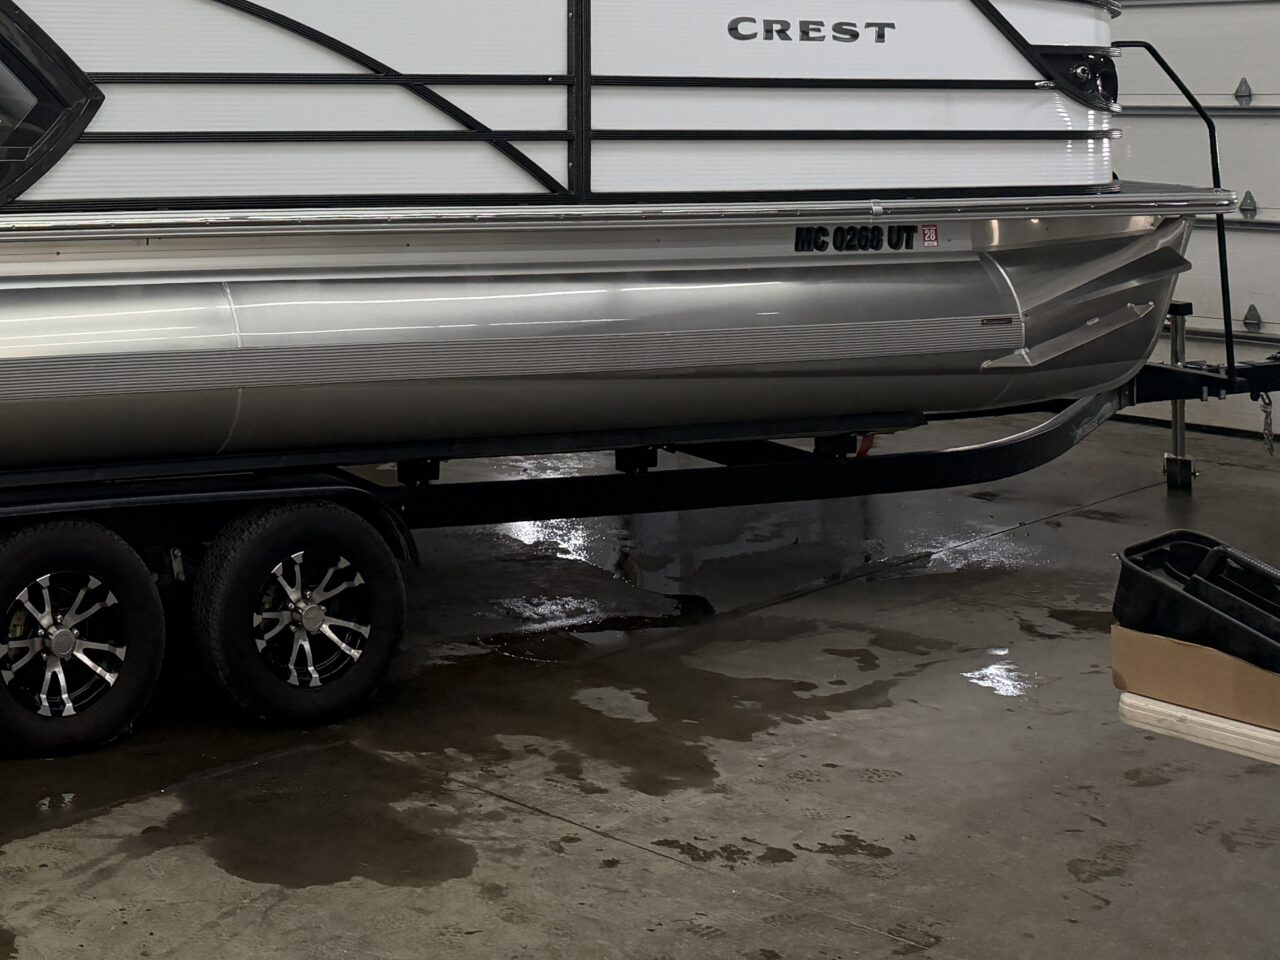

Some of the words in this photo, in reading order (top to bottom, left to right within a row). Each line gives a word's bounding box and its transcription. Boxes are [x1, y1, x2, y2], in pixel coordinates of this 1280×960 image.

[727, 16, 896, 43] CREST
[795, 226, 830, 252] MC
[832, 225, 884, 251] 0268
[887, 225, 918, 250] UT
[924, 229, 936, 241] 28
